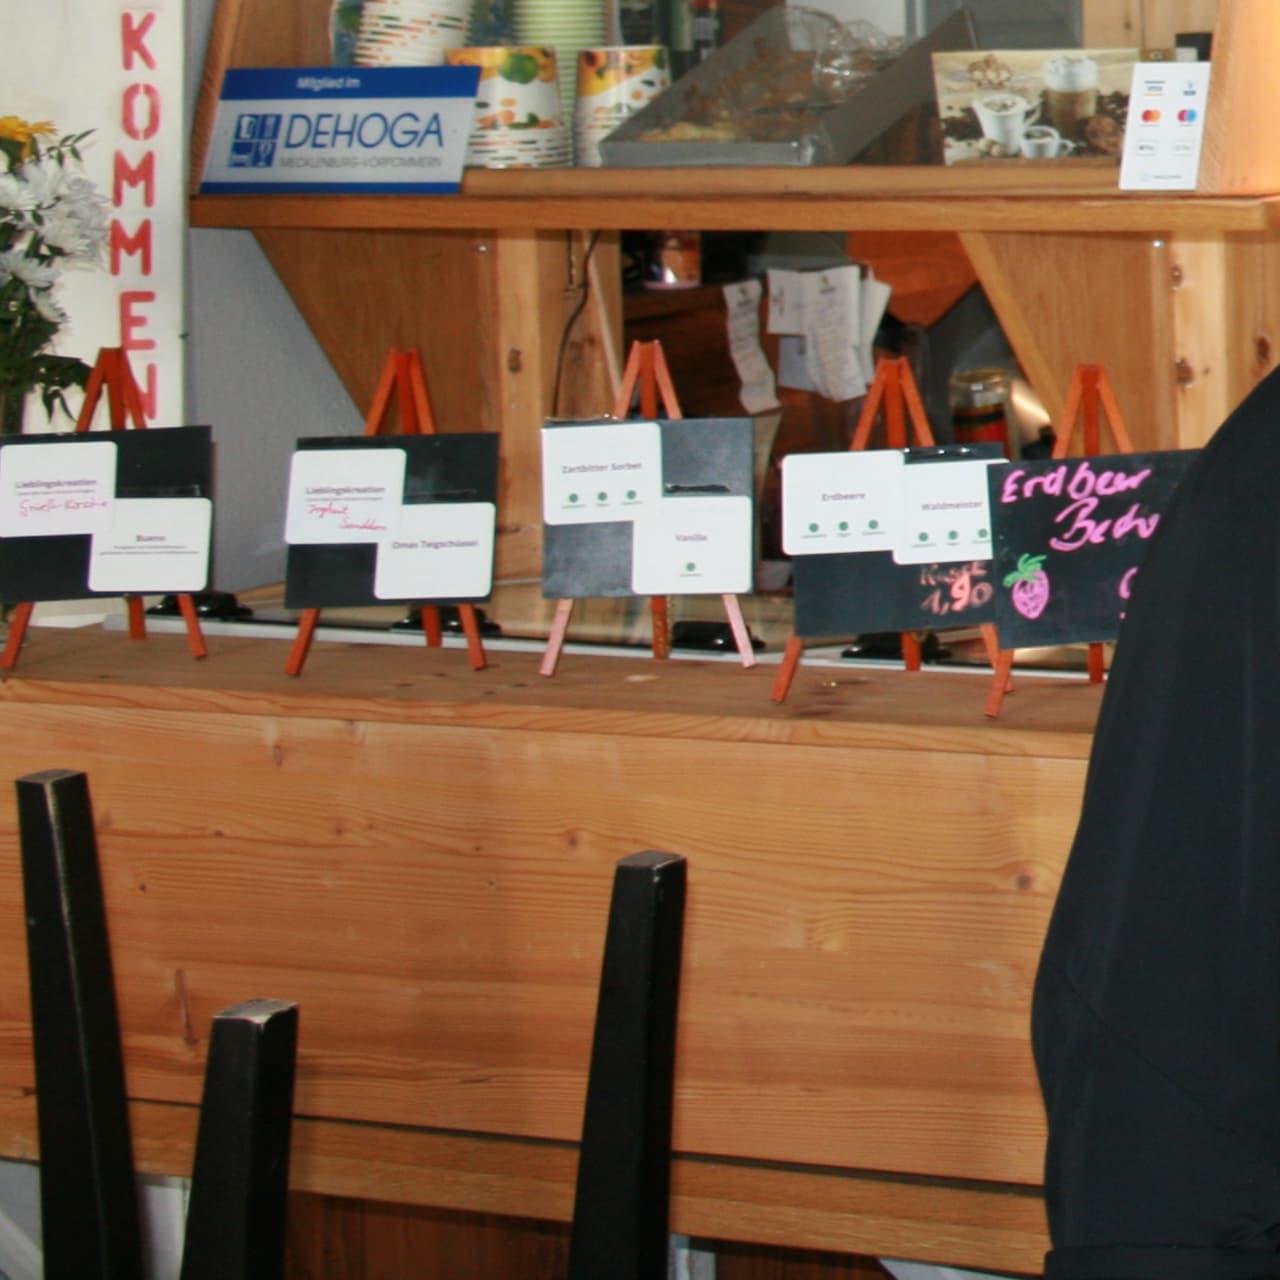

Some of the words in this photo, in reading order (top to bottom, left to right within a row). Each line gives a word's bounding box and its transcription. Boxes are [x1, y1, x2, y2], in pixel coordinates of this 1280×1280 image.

[297, 76, 344, 92] Mitglied
[346, 77, 361, 89] im
[284, 112, 444, 148] DEHOGA
[1001, 461, 1152, 503] Erdbeer
[821, 492, 865, 502] Erdbeere
[675, 533, 708, 542] Vanille
